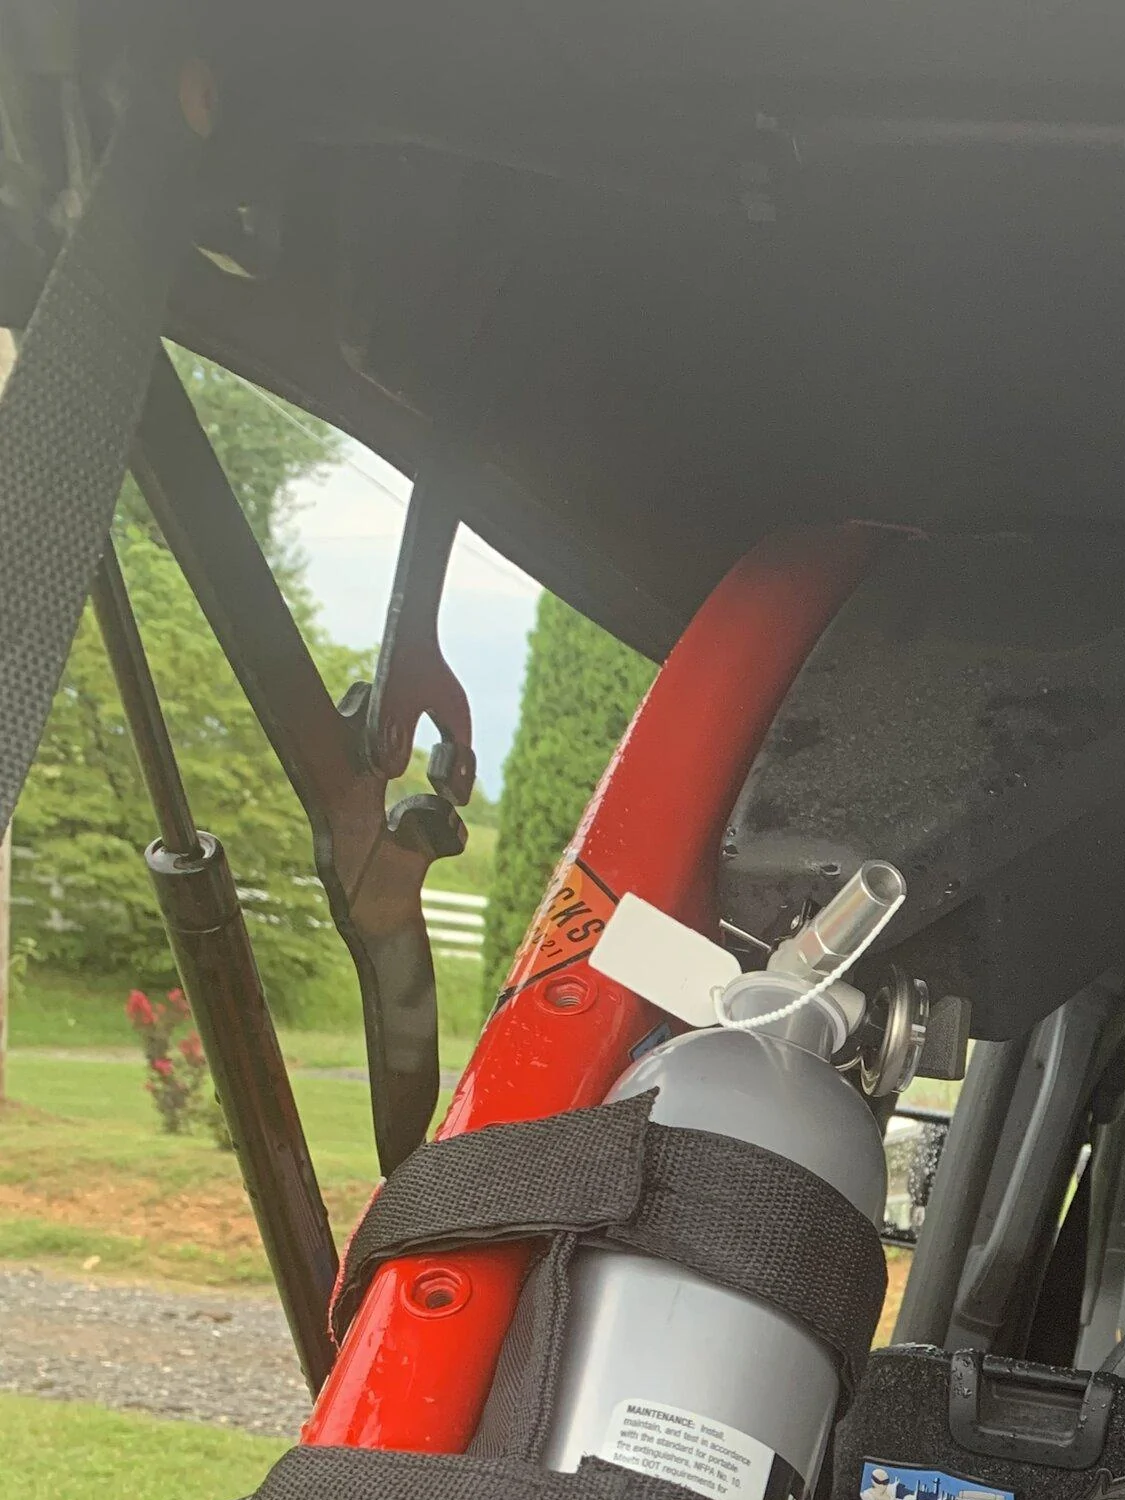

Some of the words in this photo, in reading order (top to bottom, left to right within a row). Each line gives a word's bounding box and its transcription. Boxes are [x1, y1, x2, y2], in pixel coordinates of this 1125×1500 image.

[627, 1404, 695, 1429] MAINTENANCE:
[620, 1429, 638, 1440] with
[641, 1433, 654, 1444] the
[656, 1438, 694, 1454] standard
[695, 1448, 706, 1458] for
[708, 1454, 738, 1473] portable
[664, 1427, 681, 1438] and
[701, 1437, 708, 1446] in
[710, 1441, 751, 1466] accordance
[642, 1456, 660, 1470] DOT
[662, 1465, 716, 1490] requirements
[717, 1482, 728, 1494] for
